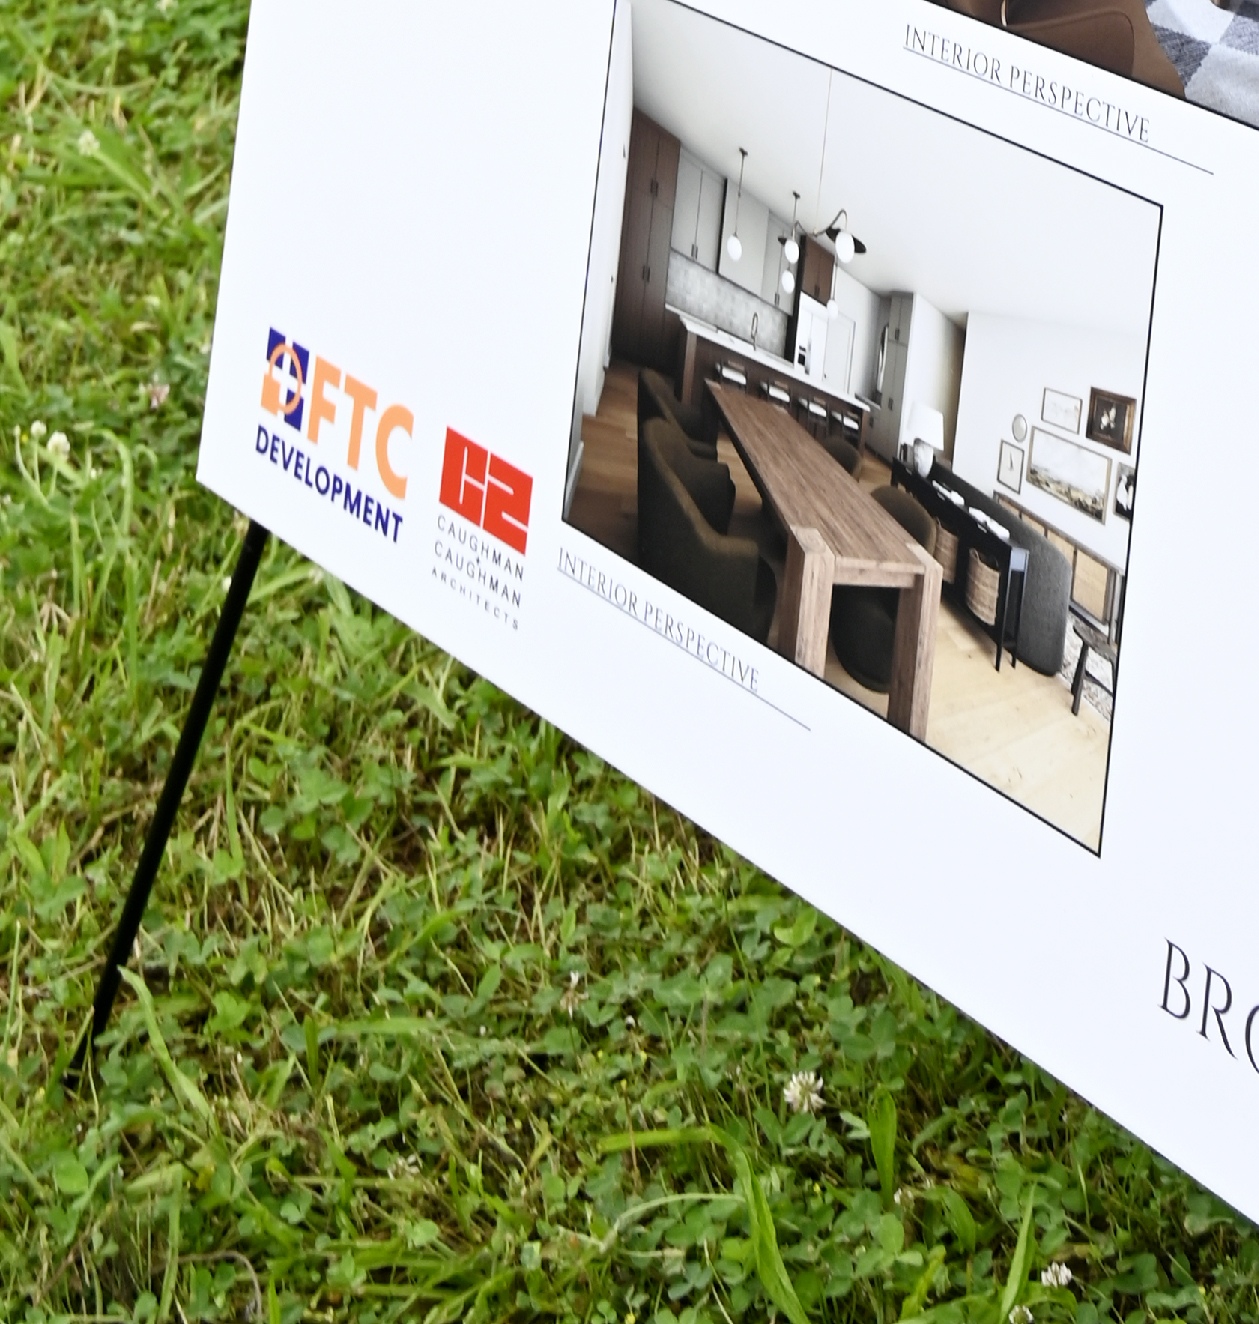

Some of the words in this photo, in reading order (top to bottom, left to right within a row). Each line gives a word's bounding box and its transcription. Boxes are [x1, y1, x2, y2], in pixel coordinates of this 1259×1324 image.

[904, 24, 1001, 82] INTERIOR
[1009, 65, 1150, 143] PERSPECTIVE
[255, 424, 403, 544] DEVELOPMENT
[306, 354, 415, 500] FTC
[431, 567, 519, 631] ARCHITECTS
[433, 541, 522, 609] CAUGHMAN
[437, 514, 525, 582] CAUGHMAN
[557, 547, 638, 617] INTERIOR
[643, 601, 760, 693] PERSPECTIVE
